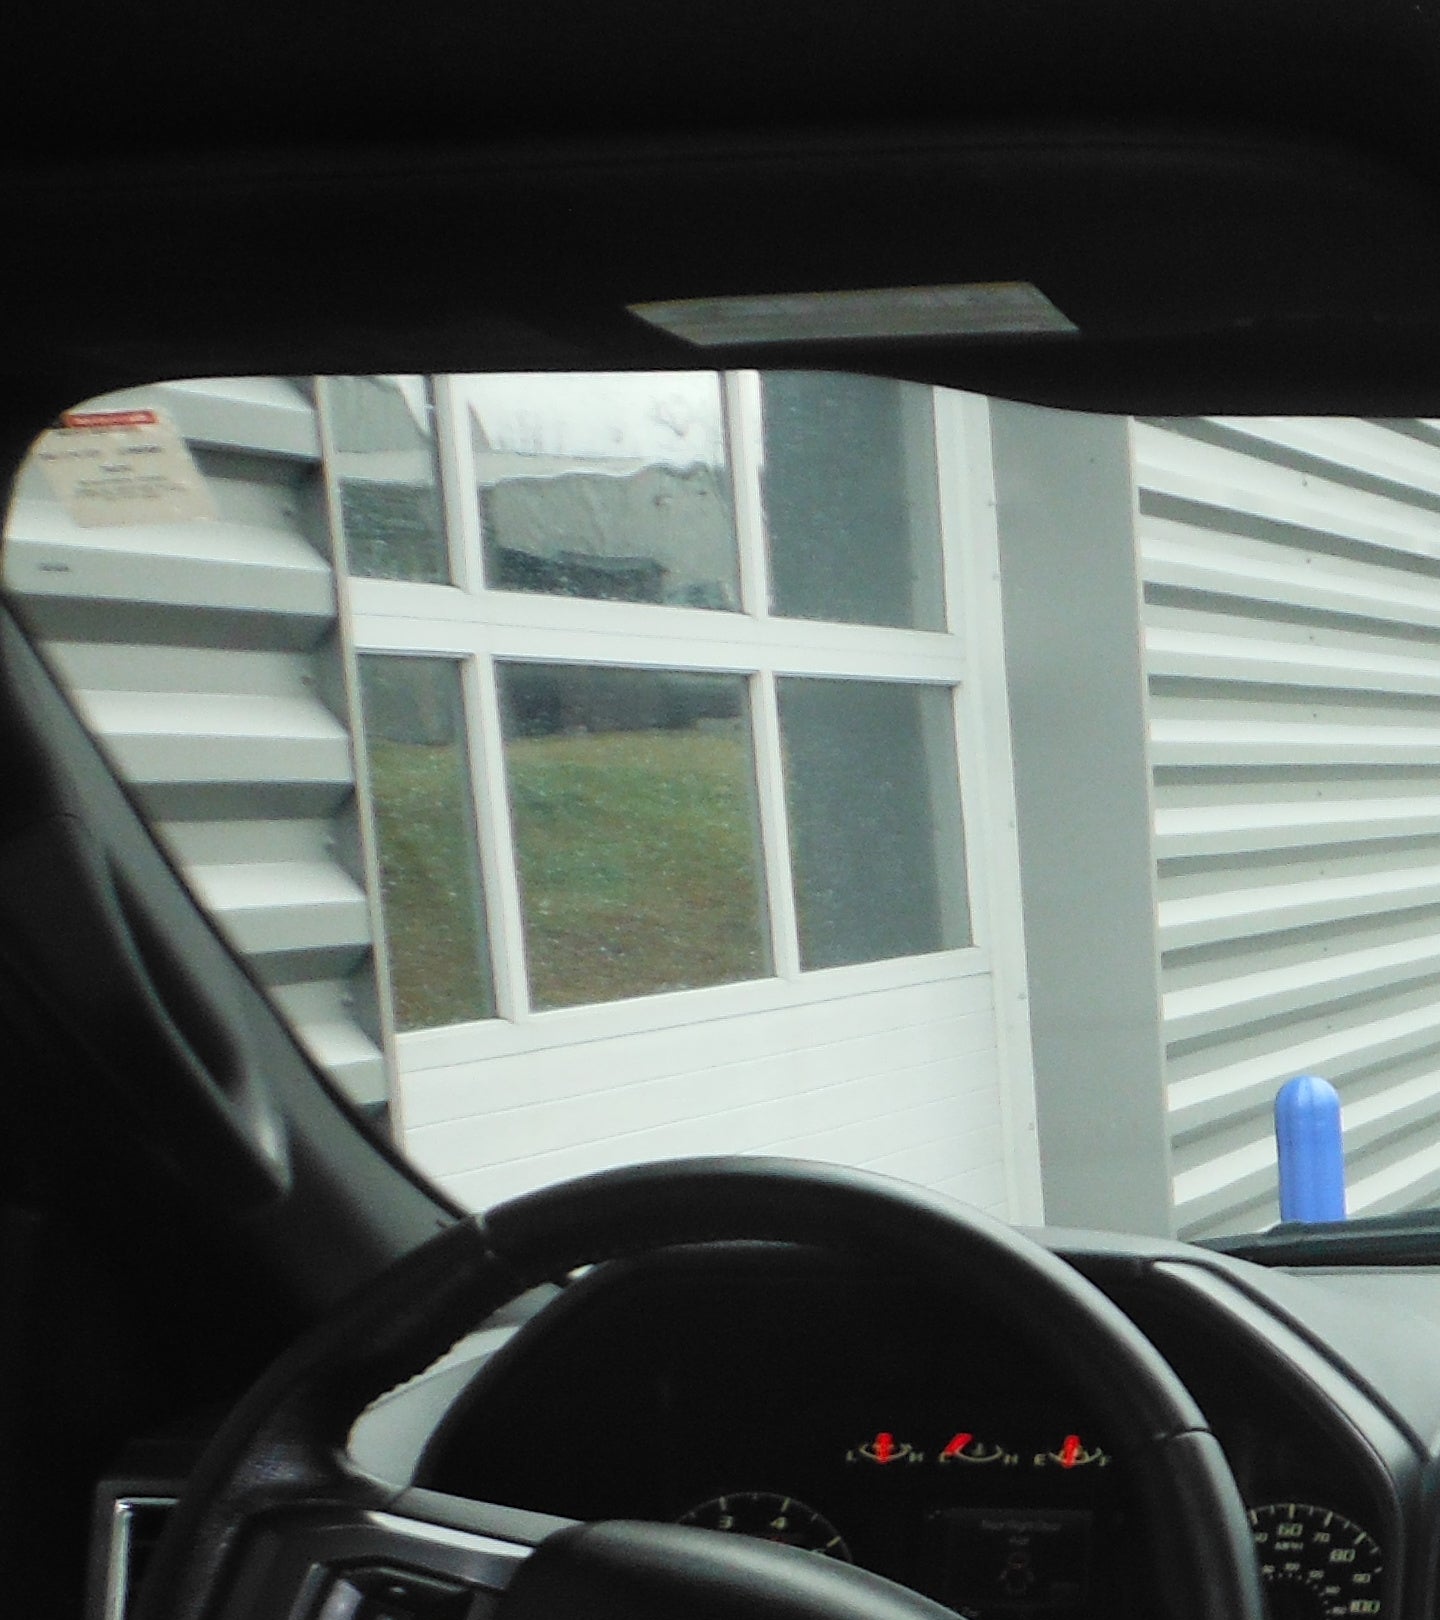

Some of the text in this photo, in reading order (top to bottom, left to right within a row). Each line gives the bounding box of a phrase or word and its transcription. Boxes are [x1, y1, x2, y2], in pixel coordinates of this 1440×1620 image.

[719, 1515, 734, 1529] 3
[1277, 1523, 1304, 1537] 60
[1329, 1548, 1357, 1563] 80
[1349, 1599, 1381, 1614] 100
